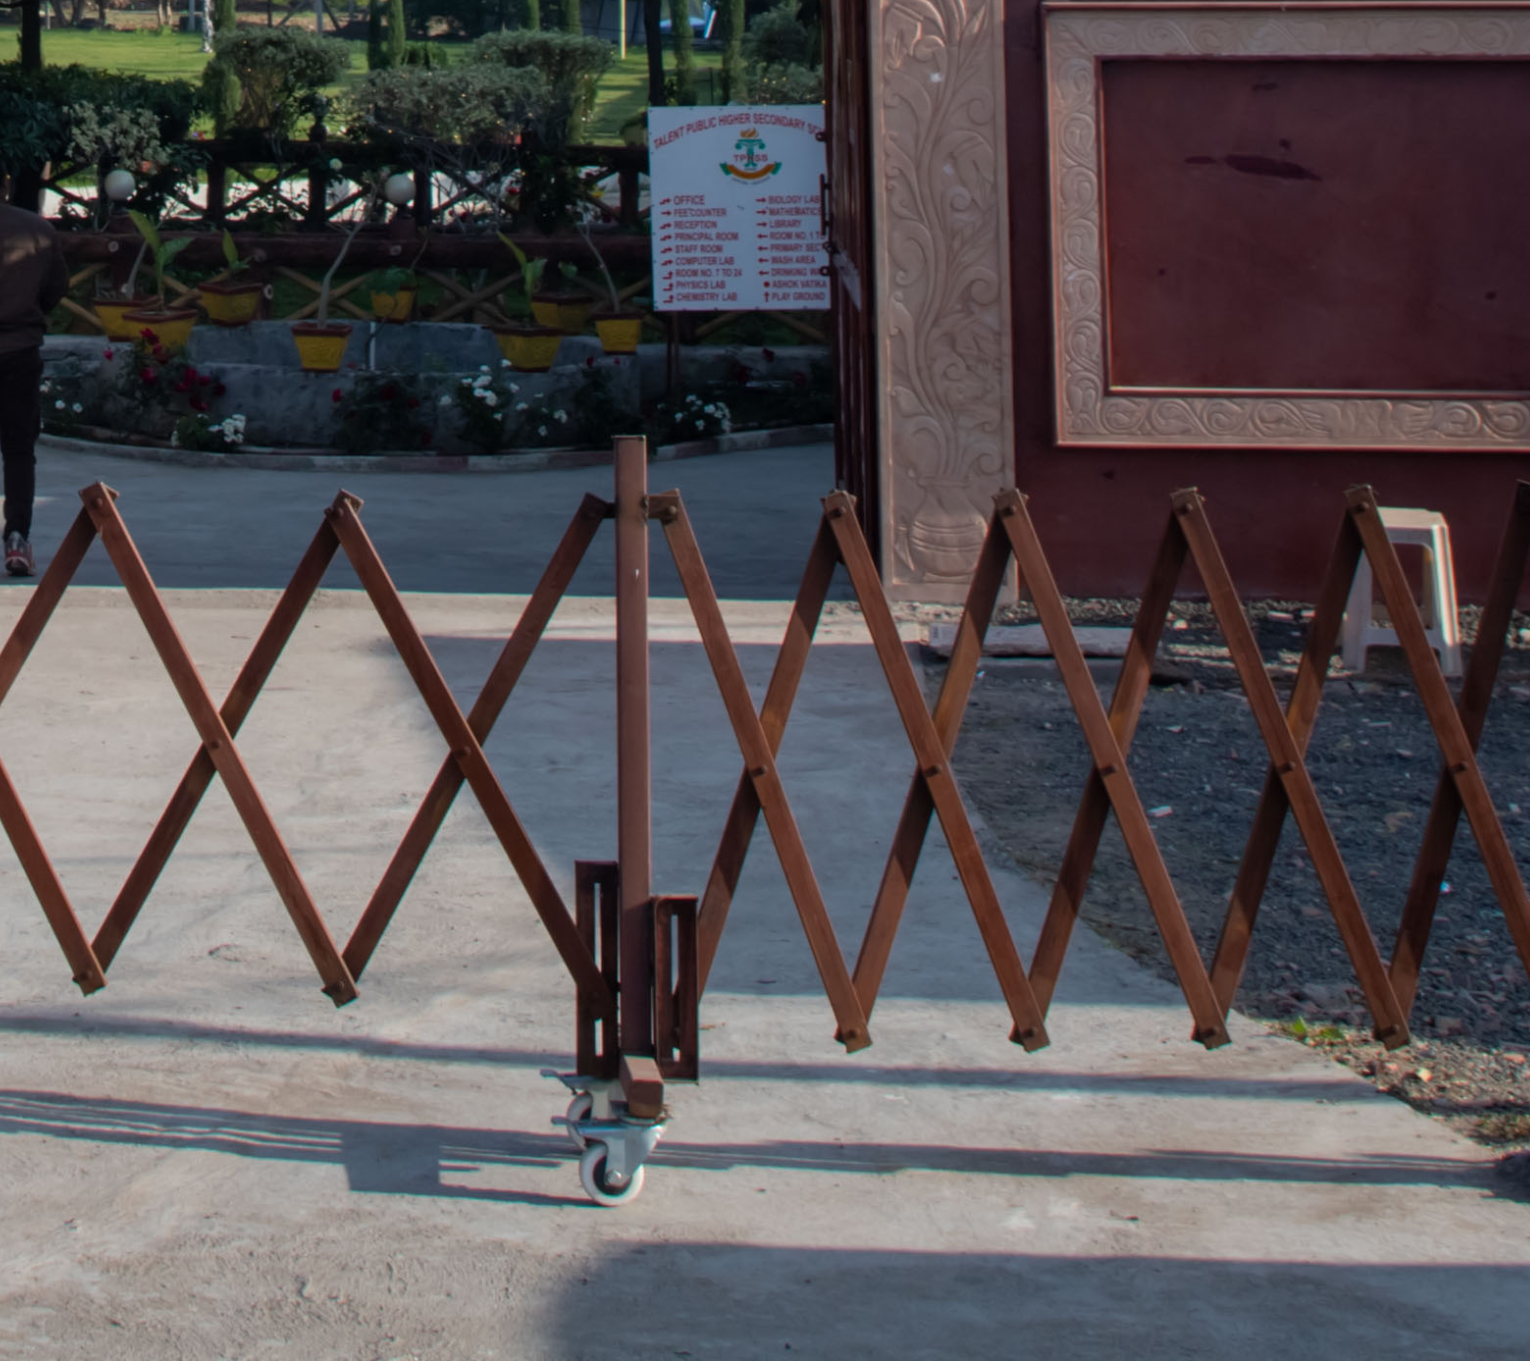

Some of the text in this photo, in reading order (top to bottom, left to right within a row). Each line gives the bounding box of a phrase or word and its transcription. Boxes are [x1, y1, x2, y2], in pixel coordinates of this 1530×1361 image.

[653, 126, 684, 149] TALENT
[686, 117, 717, 135] PUBLIC
[718, 113, 751, 126] HIGHER
[753, 113, 805, 130] SECONDARY
[674, 195, 705, 205] OFFICE
[768, 195, 802, 204] BIOLOGY
[674, 208, 726, 217] FEE COUNTER
[674, 221, 718, 229] RECEPTION
[770, 219, 801, 229] LIBRARY
[674, 233, 738, 241] PRINCIPAL ROOM
[770, 231, 793, 240] ROOM
[675, 245, 723, 253] STAFF ROOM
[770, 243, 803, 252] PRIMARY
[676, 257, 734, 265] COMPUTER LAB
[771, 255, 816, 264] WASH AREA
[676, 269, 698, 277] ROOM
[722, 269, 732, 277] TO
[772, 267, 808, 277] DRINKING
[676, 281, 726, 289] PHYSICS LAB
[772, 280, 798, 289] ASHOK
[676, 293, 738, 301] CHEMISTRY LAB
[772, 292, 826, 301] PLAY GROUND
